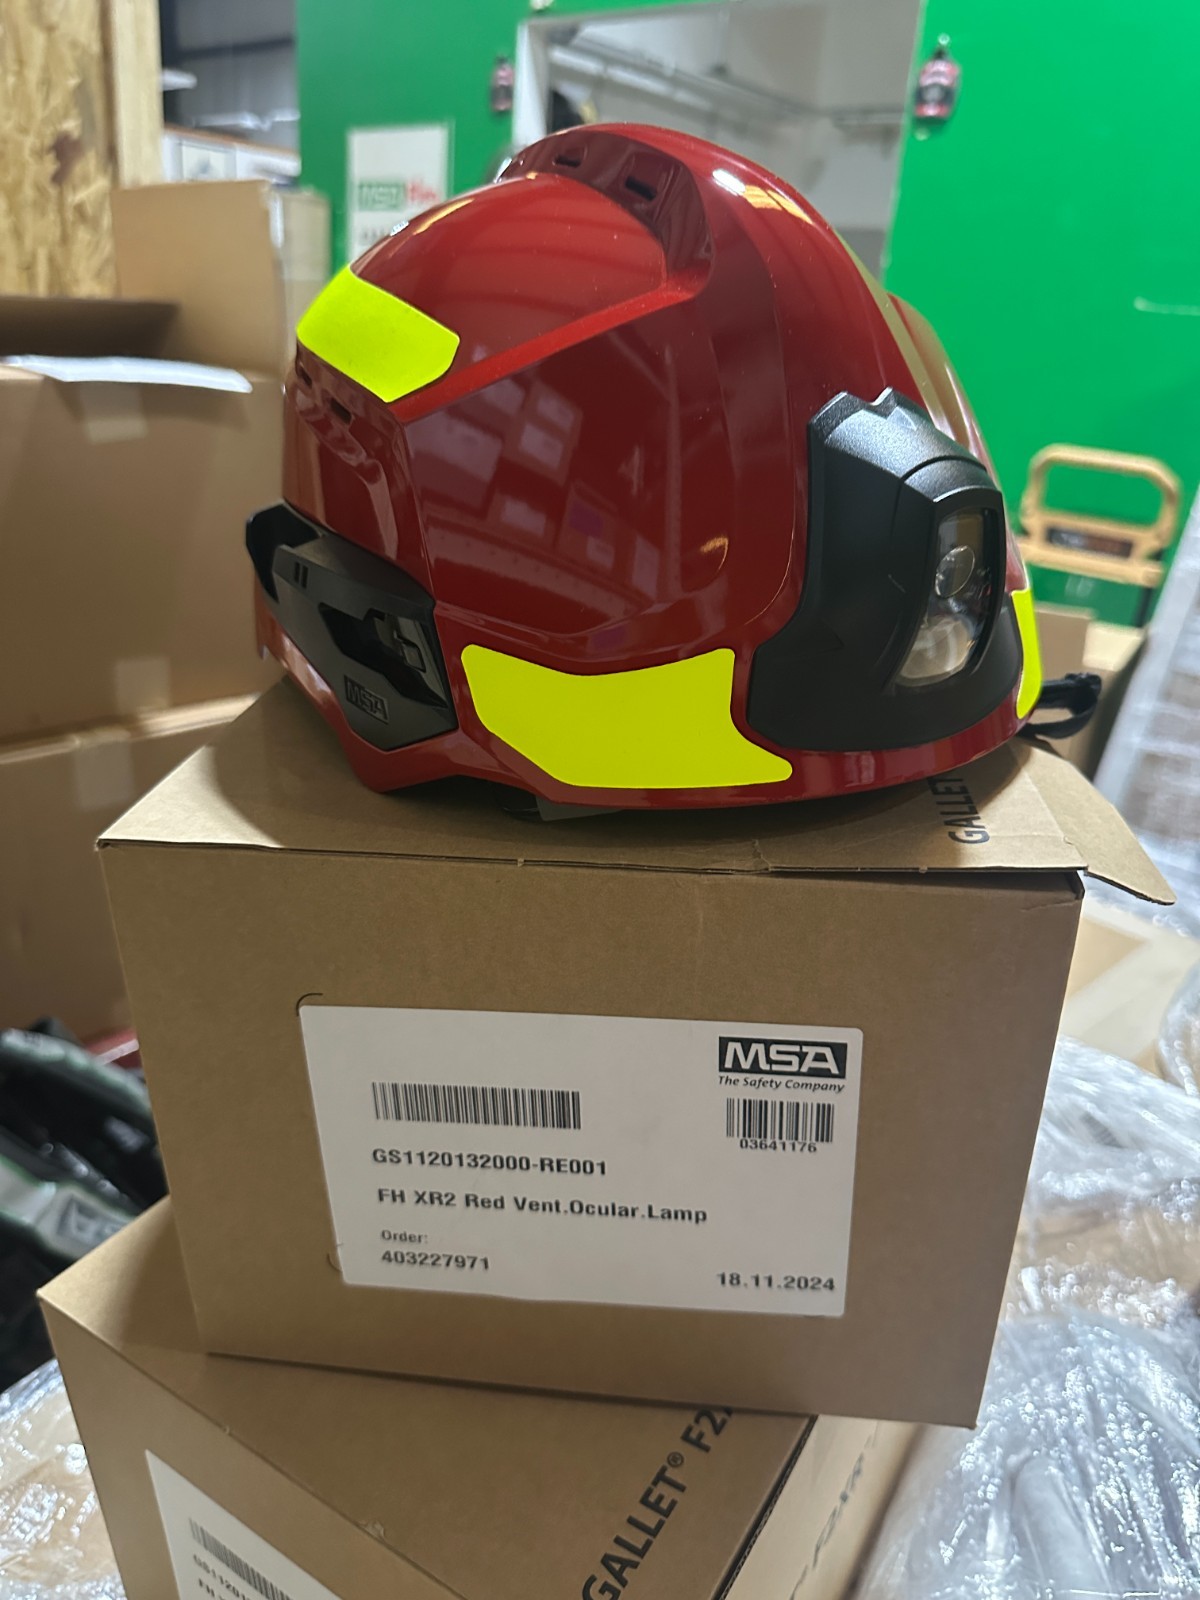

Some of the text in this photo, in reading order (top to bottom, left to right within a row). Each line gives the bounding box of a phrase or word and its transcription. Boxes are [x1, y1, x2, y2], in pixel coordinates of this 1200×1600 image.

[345, 678, 387, 722] MSA
[928, 776, 990, 844] GALLET
[723, 1040, 840, 1075] MSA
[719, 1075, 845, 1093] The Safety Company
[739, 1138, 818, 1153] 03641176
[372, 1148, 607, 1176] GS1120132000-RE001
[378, 1188, 708, 1224] FH XR2 Red Vent.Ocular.Lamp
[381, 1229, 428, 1244] Order:
[381, 1250, 490, 1270] 403227971
[716, 1271, 835, 1291] 18.11.2024
[680, 1406, 733, 1453] F2
